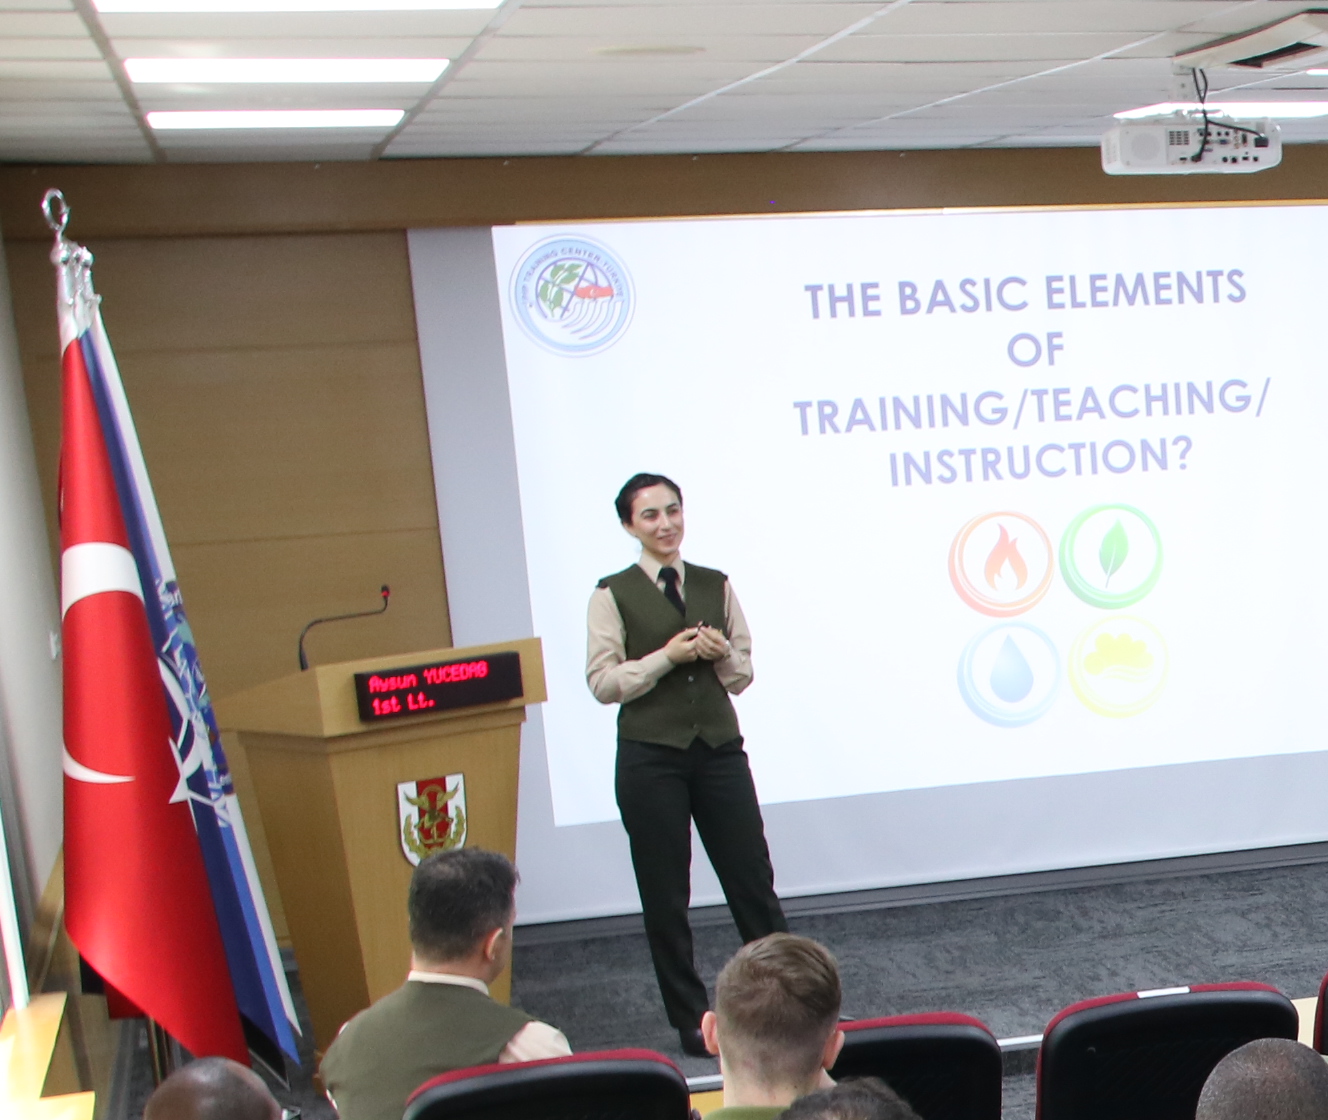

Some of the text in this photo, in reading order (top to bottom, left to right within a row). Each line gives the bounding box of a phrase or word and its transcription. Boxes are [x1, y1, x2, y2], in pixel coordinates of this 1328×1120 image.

[560, 246, 601, 263] CENTER
[803, 267, 1247, 320] THE BASIC ELEMENTS
[1006, 331, 1065, 368] OF
[792, 376, 1272, 436] TRAINING/TEACHING/
[889, 434, 1194, 487] INSTRUCTION?
[368, 673, 418, 694] Aysun
[372, 691, 436, 716] 1st Lt.
